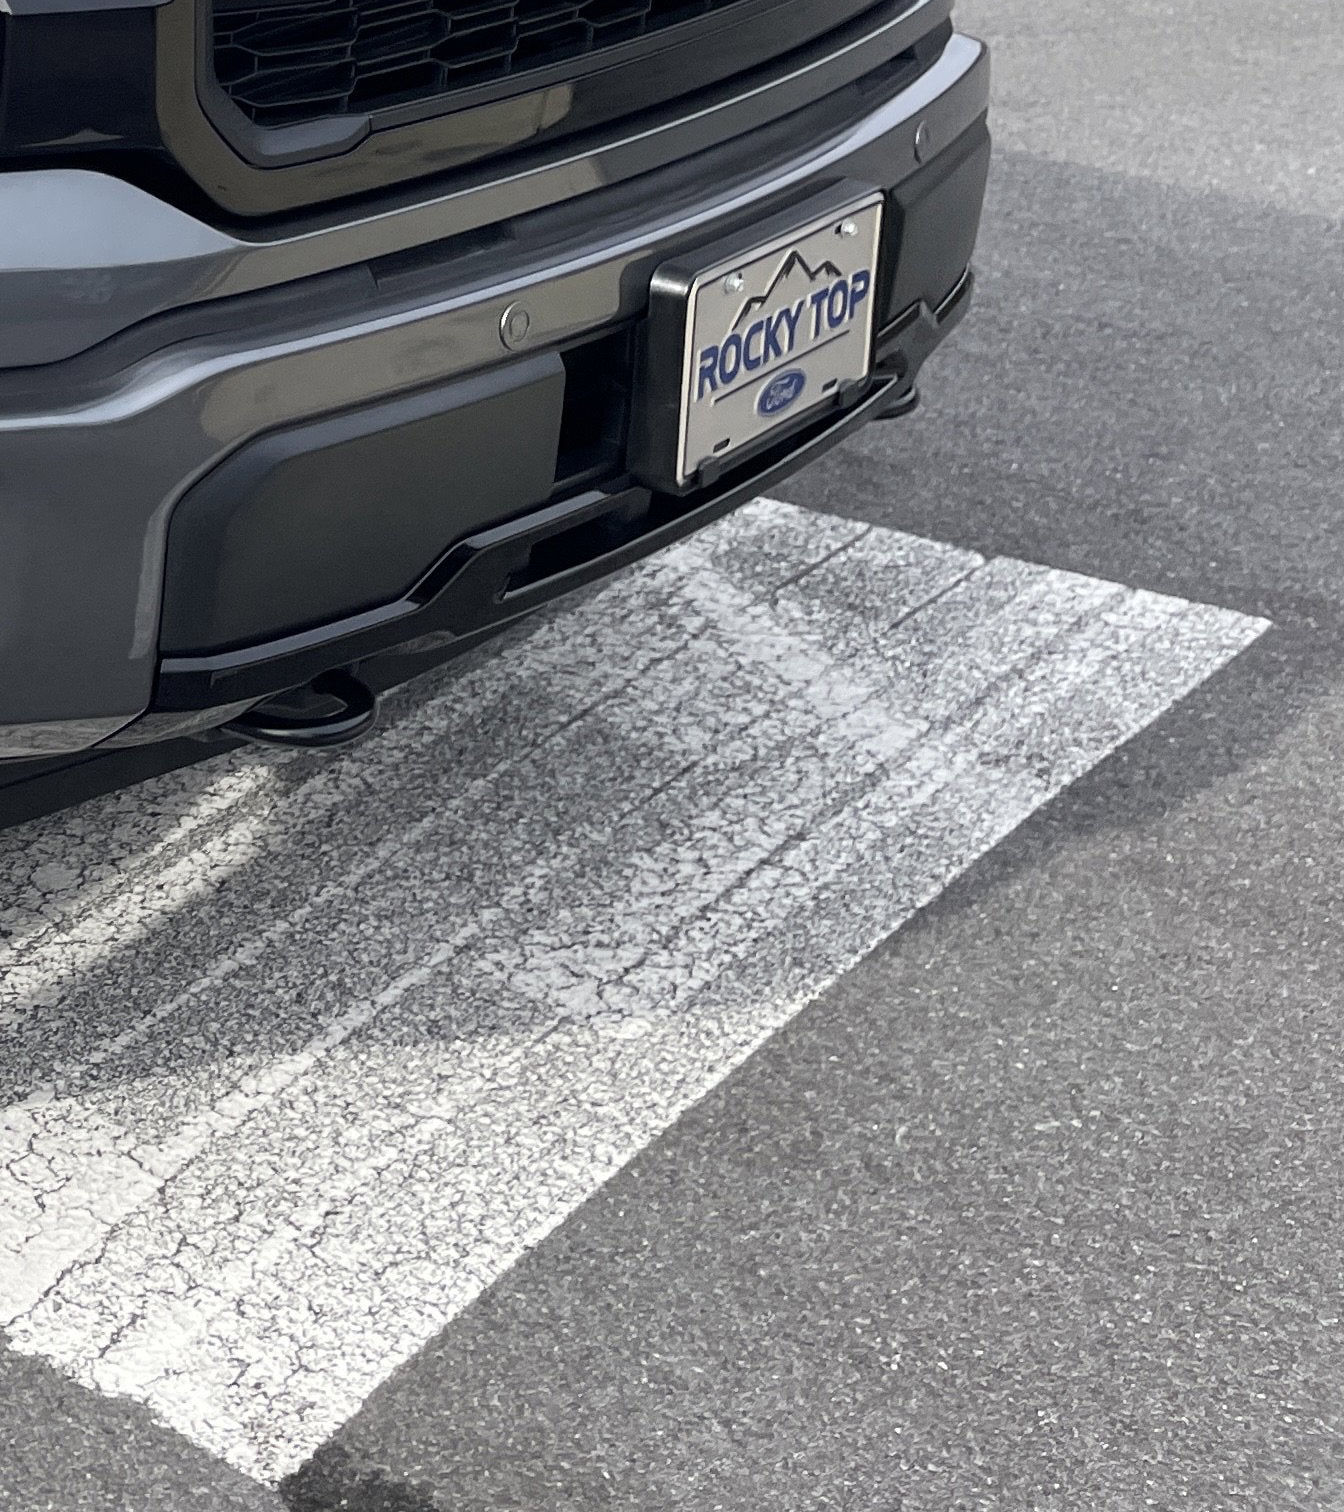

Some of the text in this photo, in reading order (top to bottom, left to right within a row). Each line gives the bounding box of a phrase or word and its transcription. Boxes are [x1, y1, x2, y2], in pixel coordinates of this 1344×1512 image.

[694, 269, 871, 402] ROCKY TOP
[766, 375, 798, 410] Ford
